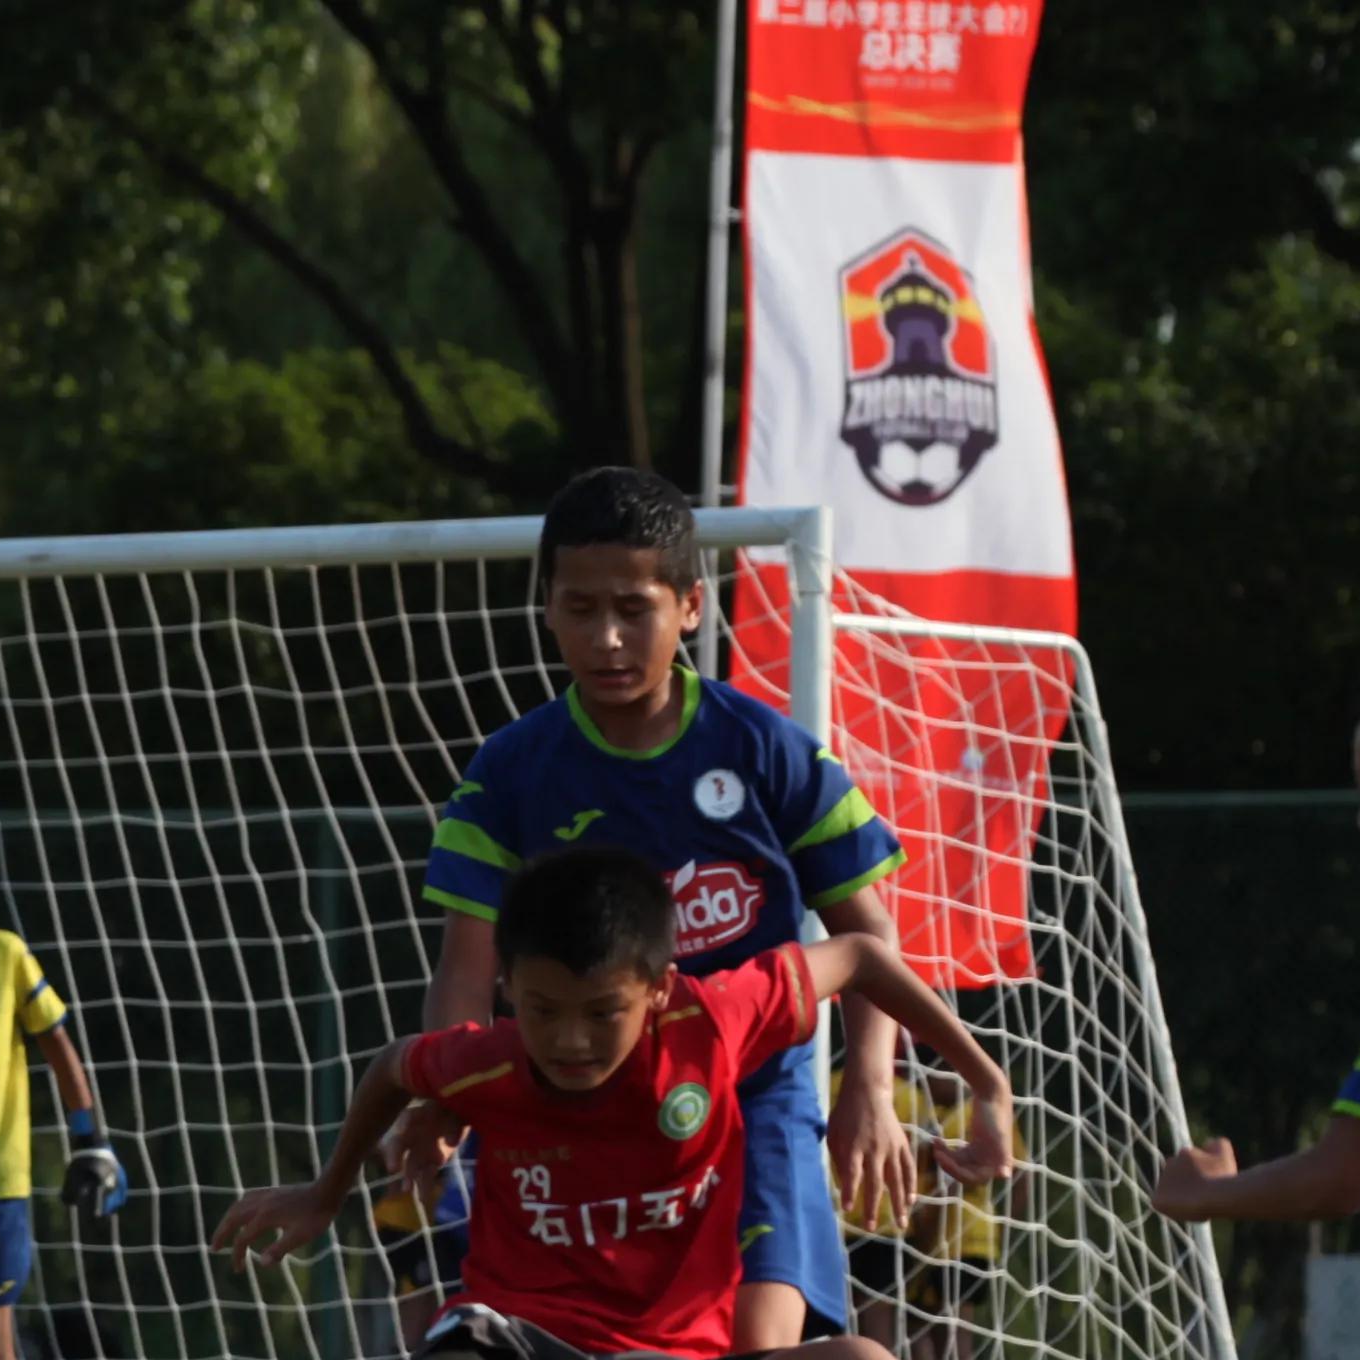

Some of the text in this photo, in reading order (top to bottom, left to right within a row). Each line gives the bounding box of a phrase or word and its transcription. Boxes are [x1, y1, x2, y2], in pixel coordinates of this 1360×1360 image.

[859, 31, 962, 72] 总决赛
[511, 1163, 551, 1201] 29
